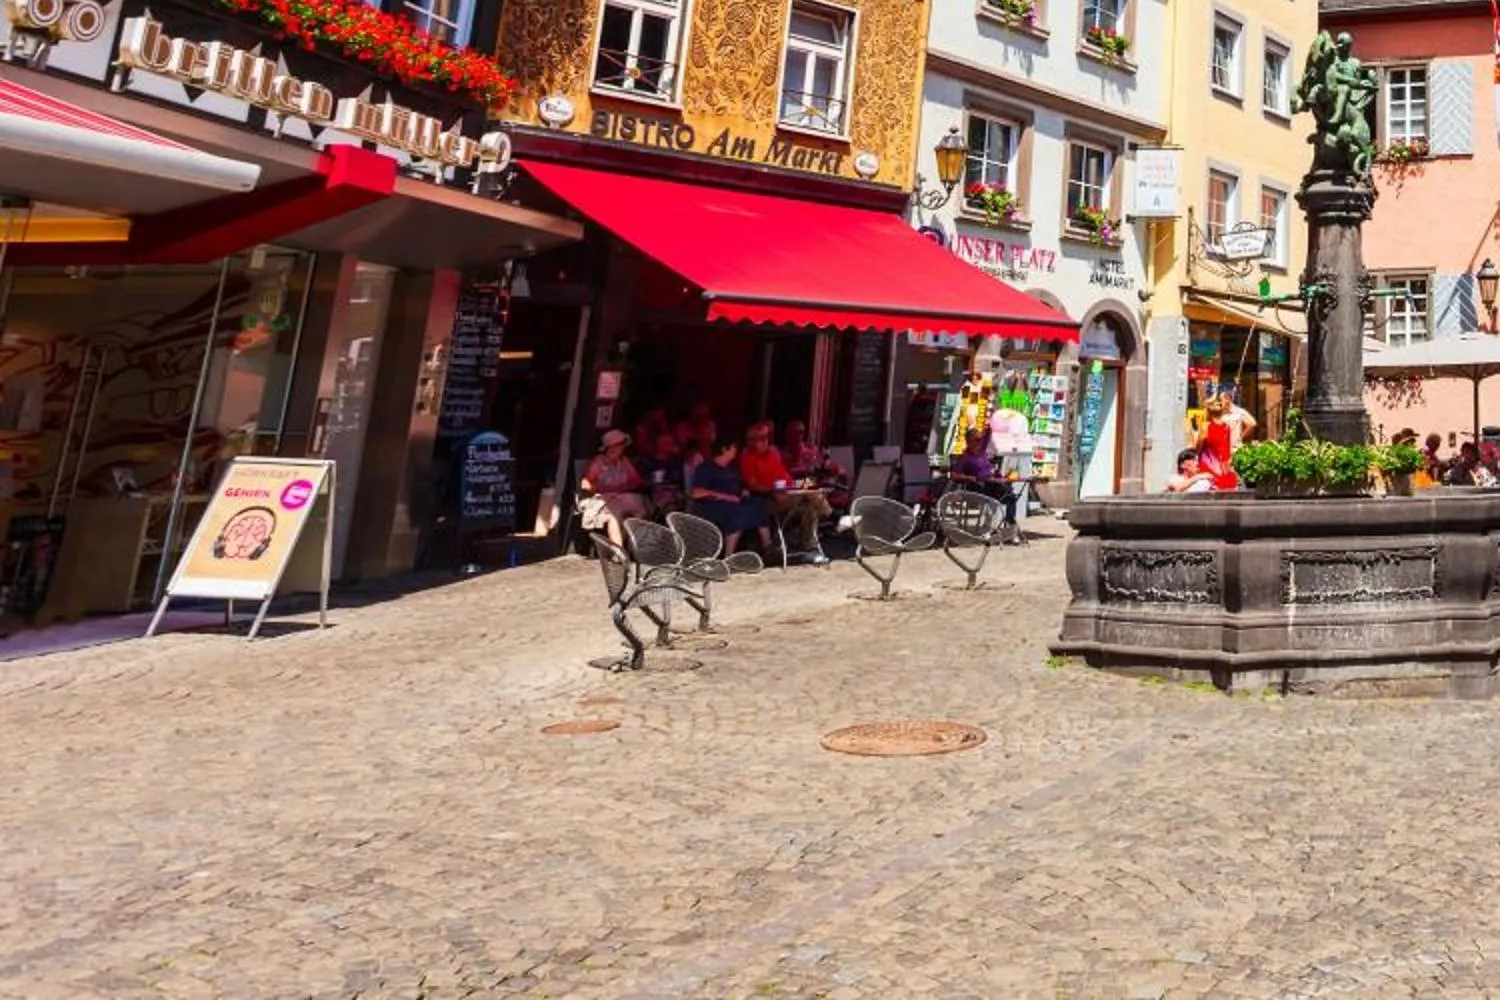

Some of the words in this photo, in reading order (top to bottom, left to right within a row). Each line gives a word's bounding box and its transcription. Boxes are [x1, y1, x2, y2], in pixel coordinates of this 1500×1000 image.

[120, 16, 333, 121] brillen
[334, 98, 480, 168] müller
[591, 109, 695, 149] BISTRO
[708, 127, 757, 158] Am
[764, 136, 844, 175] Markt
[952, 235, 1007, 263] UNSER
